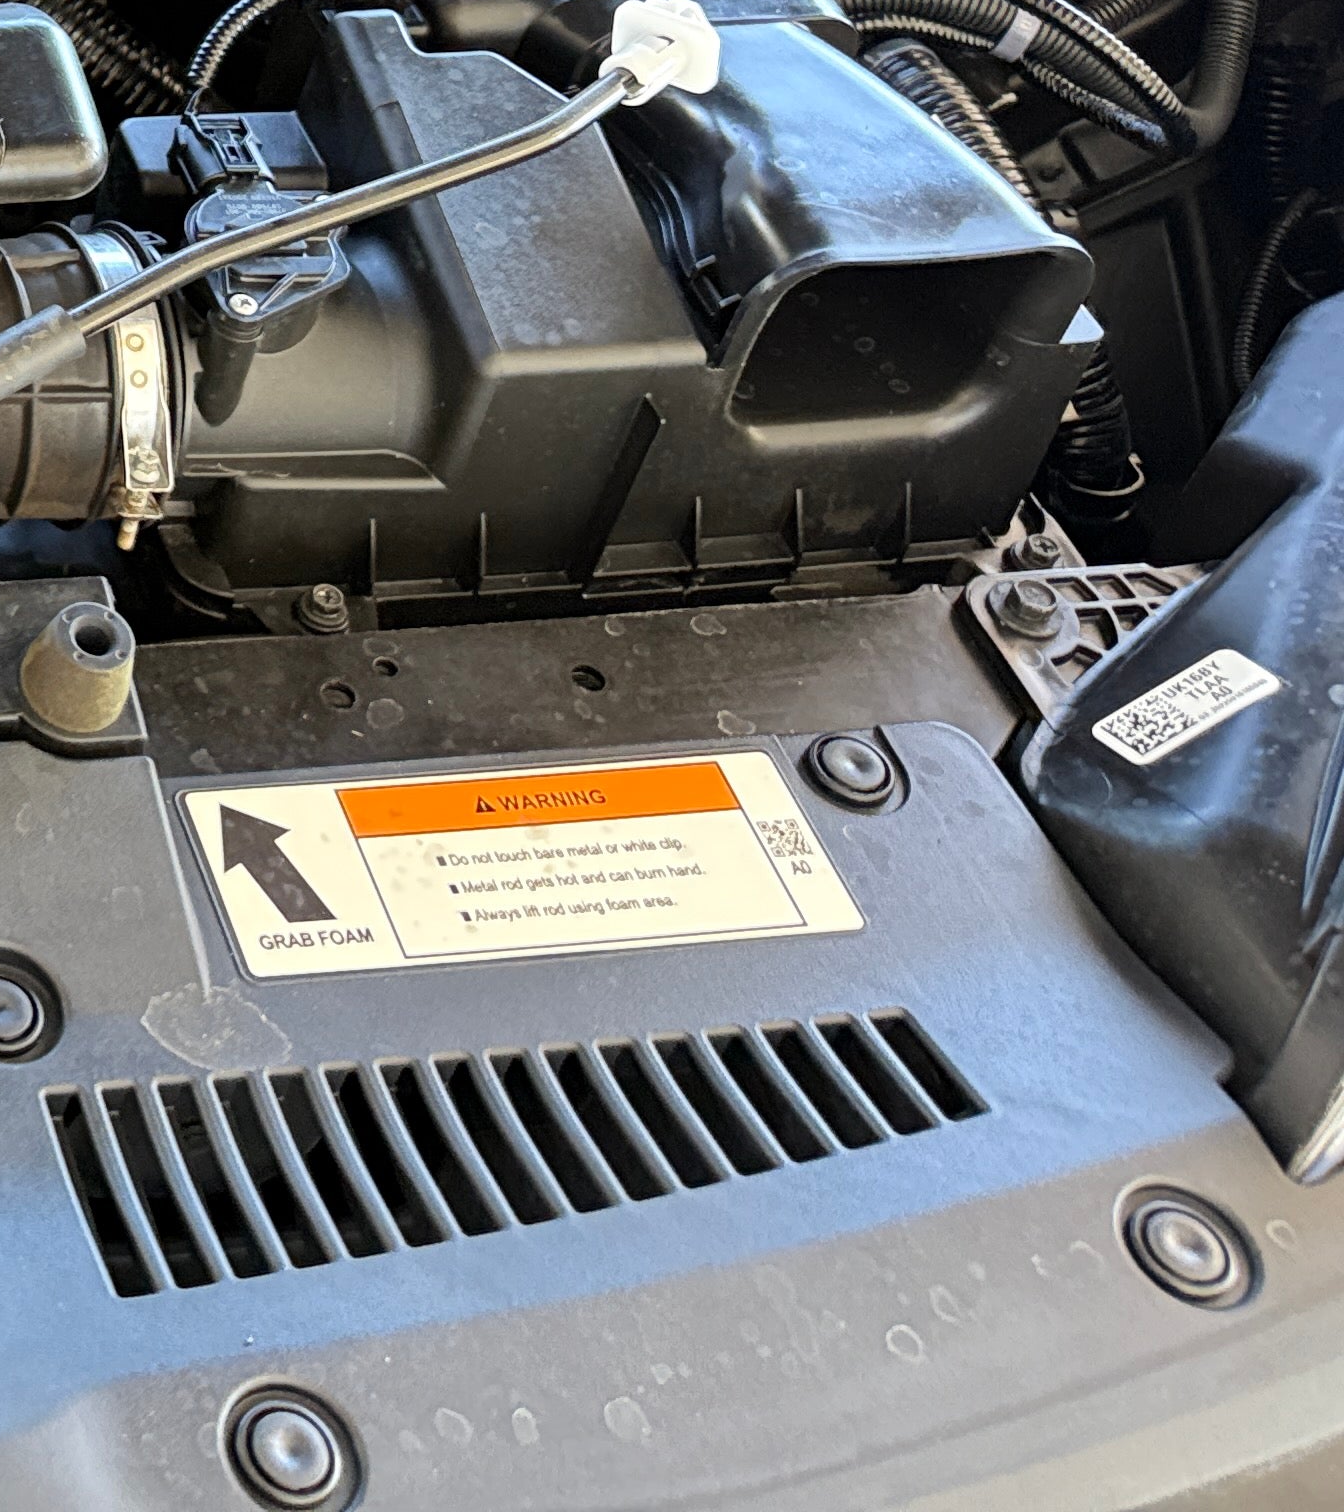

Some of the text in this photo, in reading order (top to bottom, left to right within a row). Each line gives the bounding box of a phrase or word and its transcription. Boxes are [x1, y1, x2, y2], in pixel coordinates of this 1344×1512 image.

[1185, 675, 1229, 700] TLAA
[497, 789, 607, 811] WARNING
[449, 836, 686, 866] Do not touch bare metal or white clip.
[462, 863, 706, 894] Metal rod gets hot and can burn hand.
[475, 895, 677, 923] Always lift rod using foam area.
[259, 927, 374, 951] GRAB FOAM
